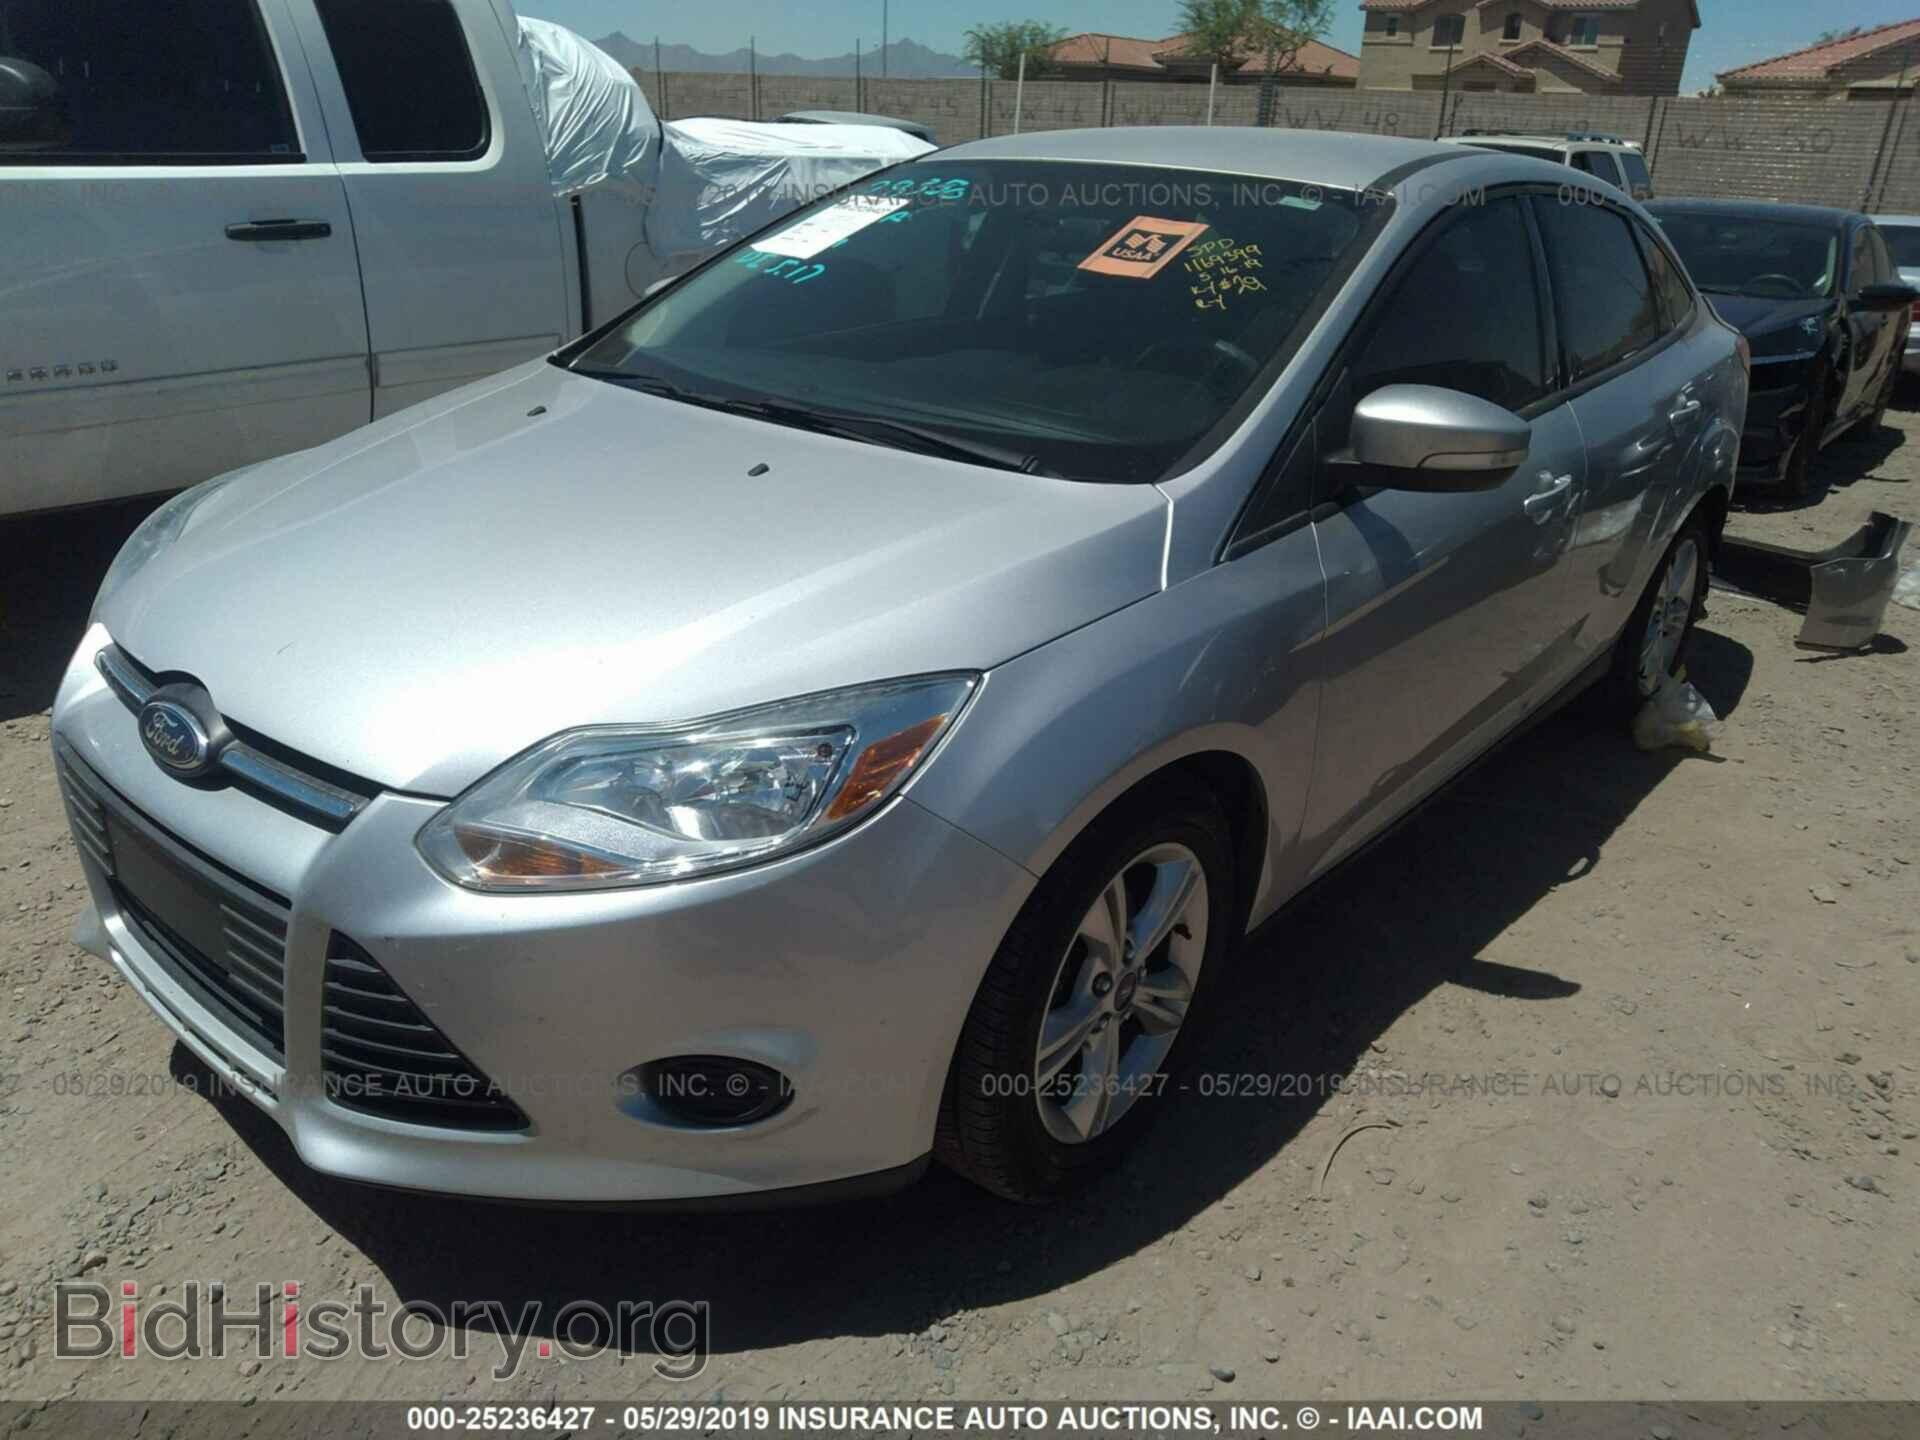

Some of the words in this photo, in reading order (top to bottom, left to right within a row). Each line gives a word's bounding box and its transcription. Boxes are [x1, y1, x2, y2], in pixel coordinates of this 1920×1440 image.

[1363, 111, 1401, 135] 48
[1111, 247, 1151, 260] USAA
[145, 711, 185, 755] Ford
